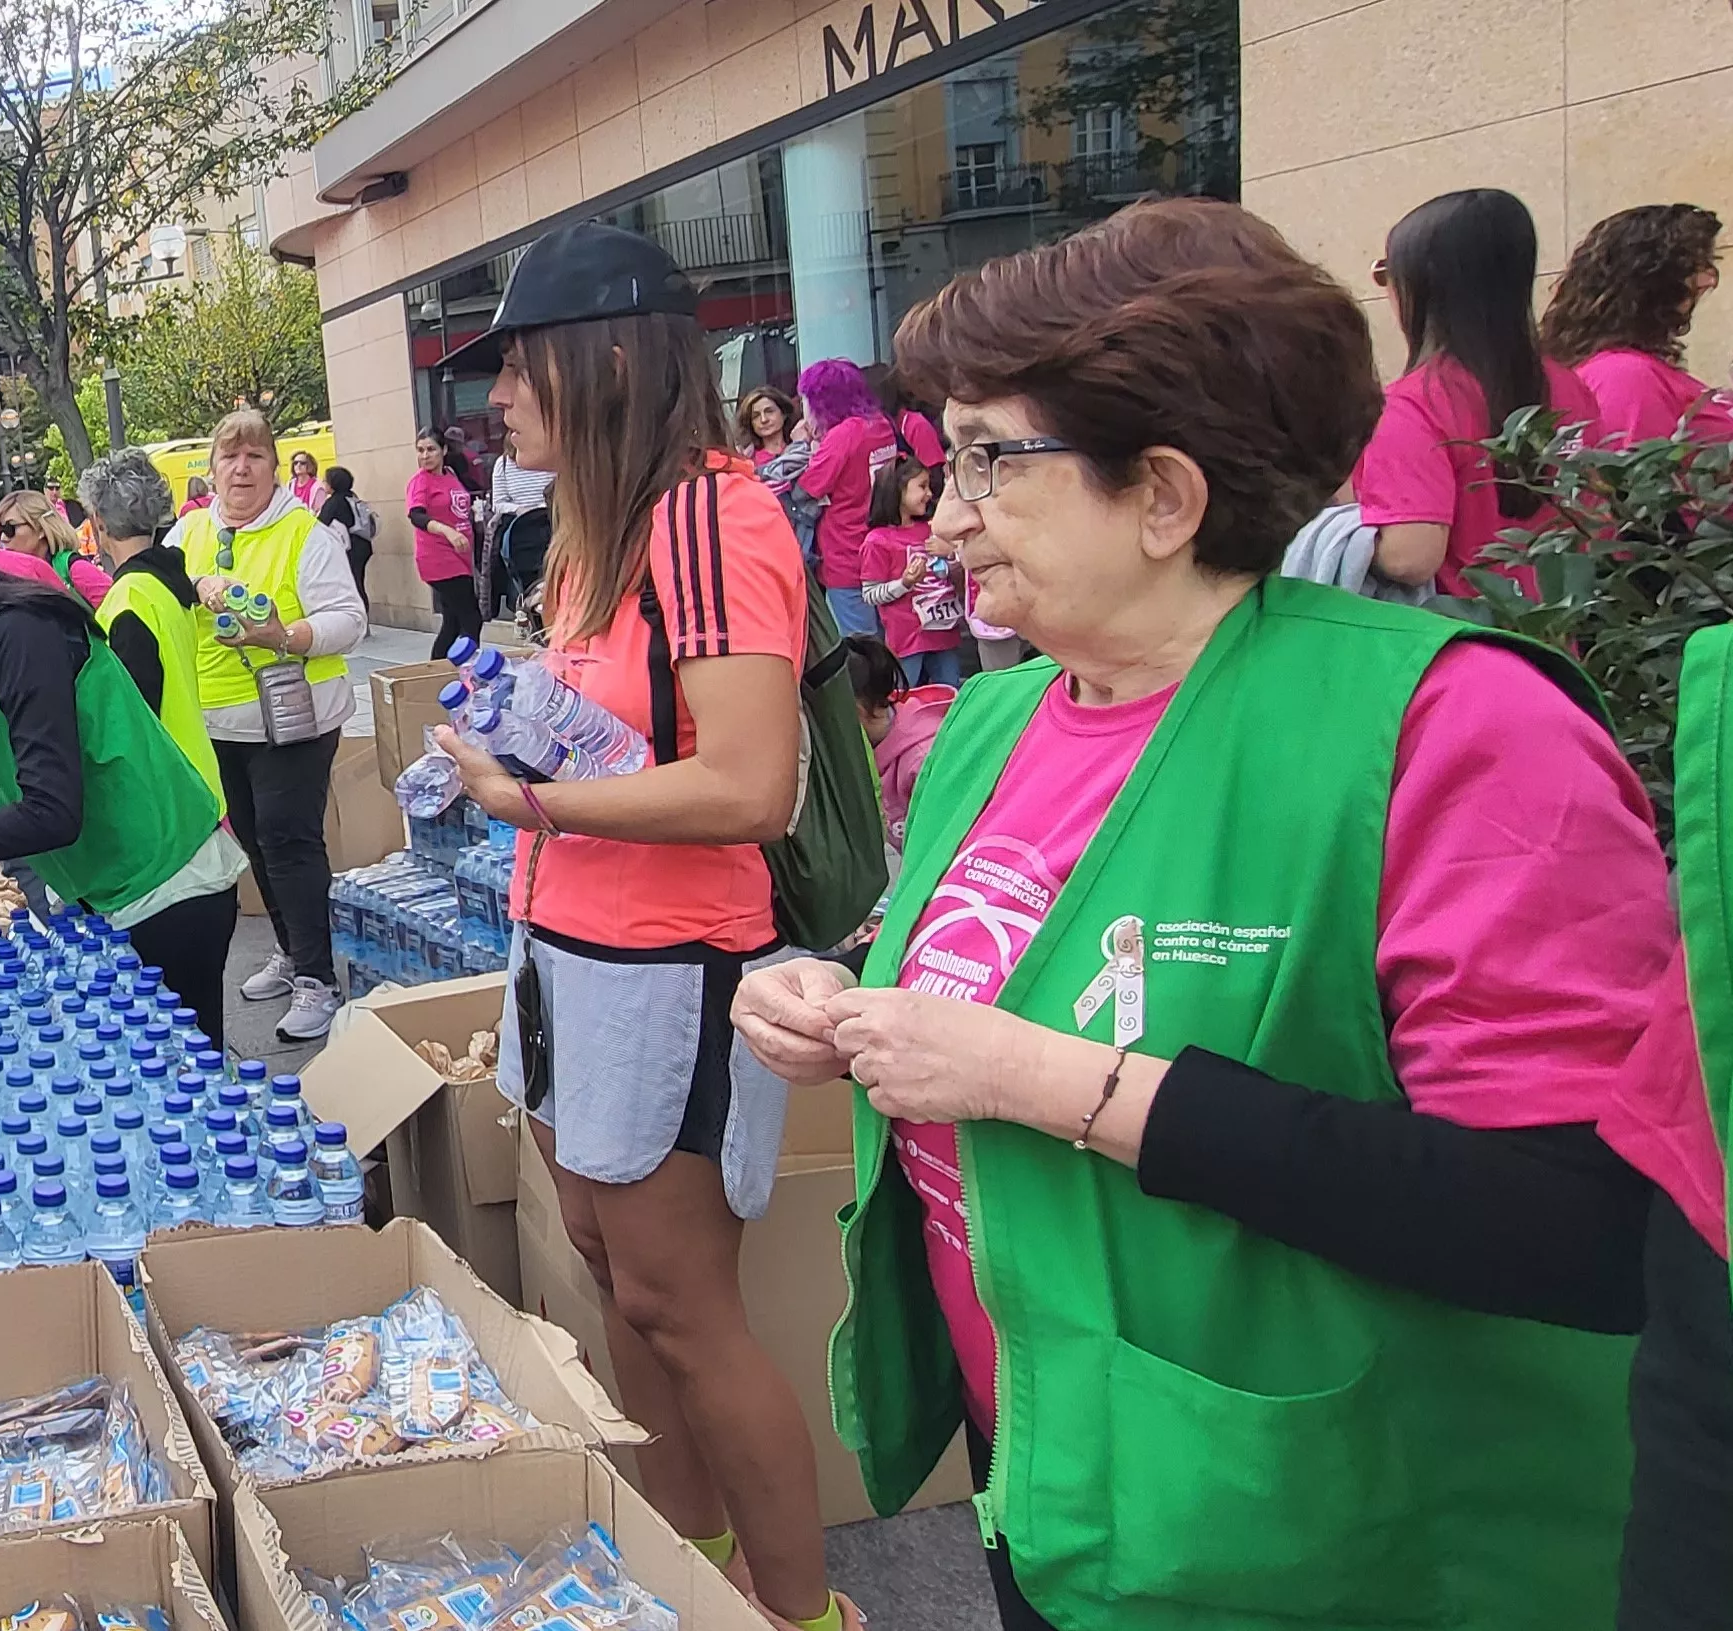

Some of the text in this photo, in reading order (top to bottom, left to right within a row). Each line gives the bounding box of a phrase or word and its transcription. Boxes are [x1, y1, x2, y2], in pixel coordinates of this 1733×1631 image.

[927, 603, 959, 622] 1571
[1156, 920, 1292, 939] asociación español
[1154, 935, 1270, 953] contra el cáncer
[1151, 949, 1227, 965] en Huesca
